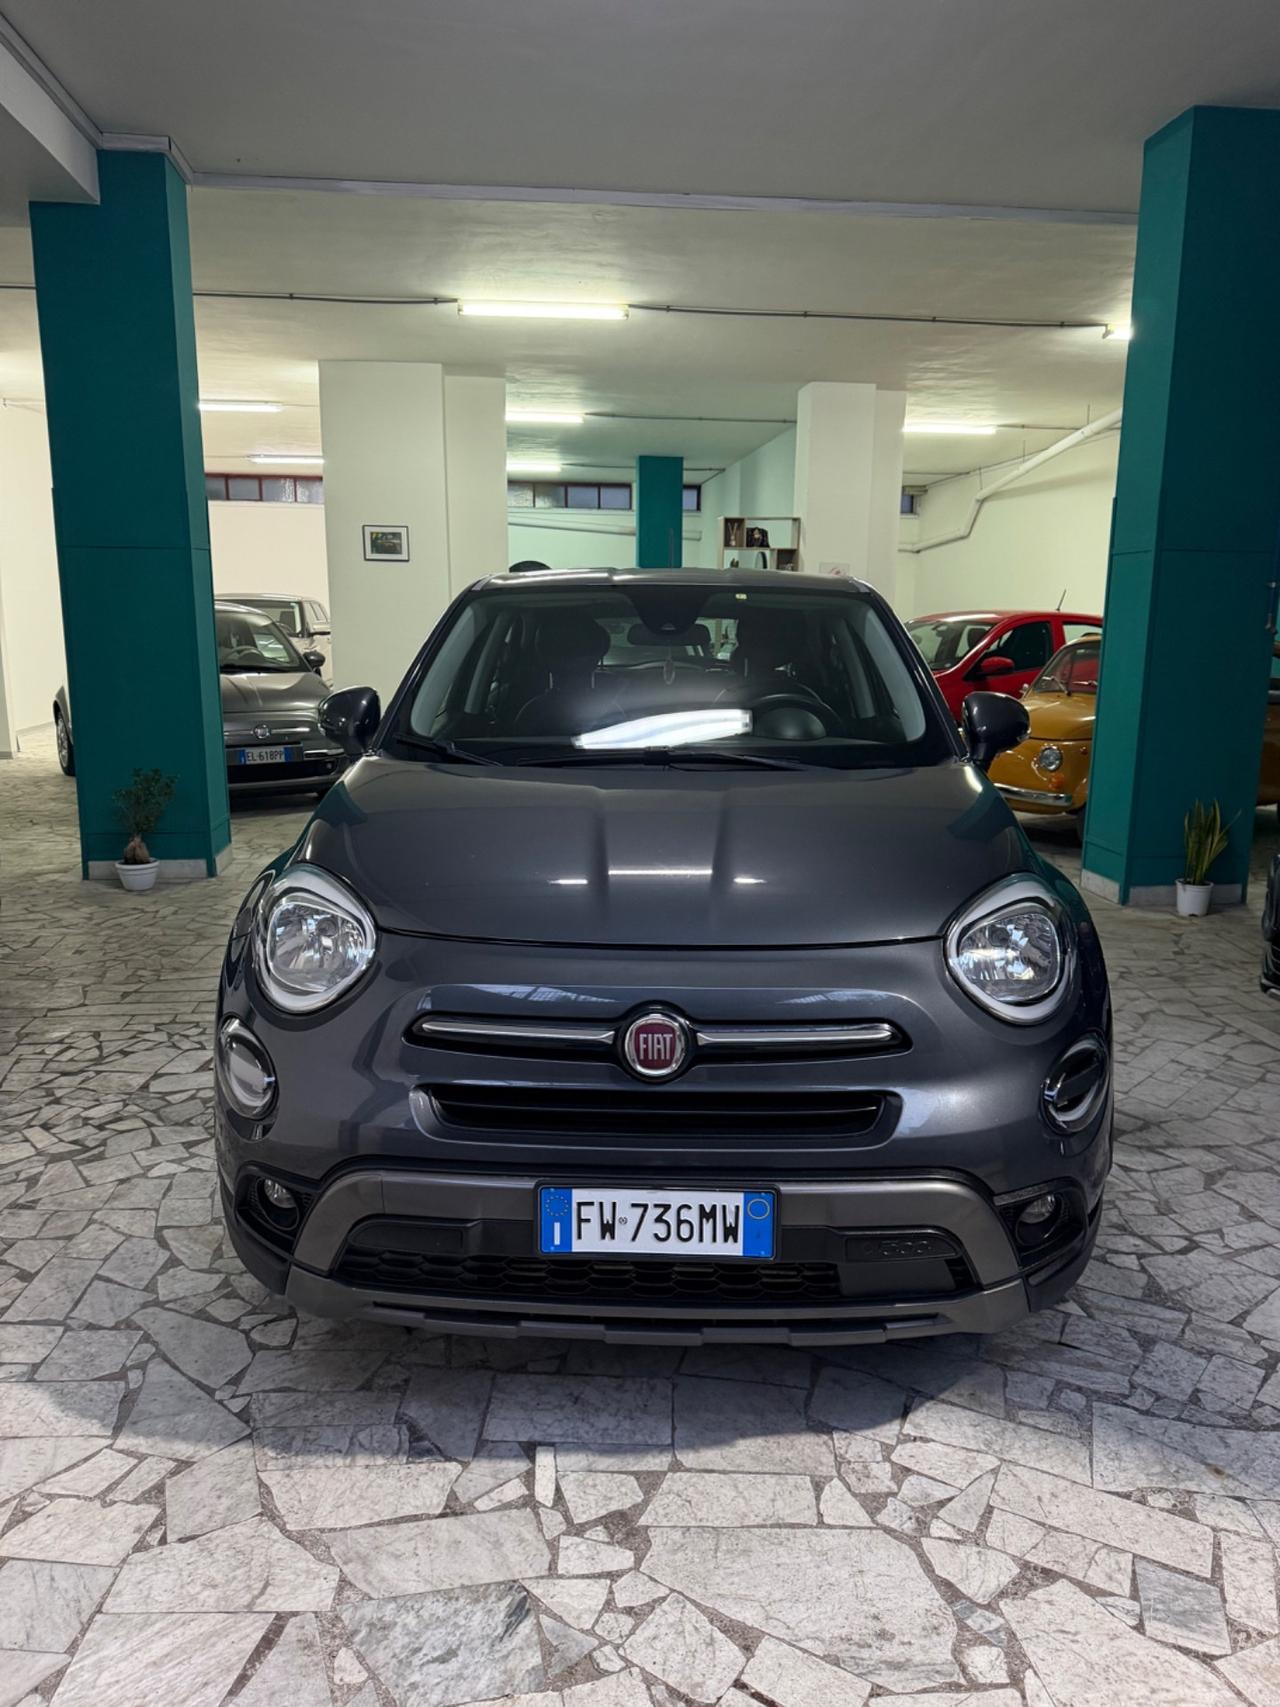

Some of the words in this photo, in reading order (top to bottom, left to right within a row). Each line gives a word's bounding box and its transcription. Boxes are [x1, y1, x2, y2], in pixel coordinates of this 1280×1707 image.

[640, 1034, 673, 1060] FIAT
[576, 1201, 617, 1241] FW
[631, 1203, 740, 1243] 736MW
